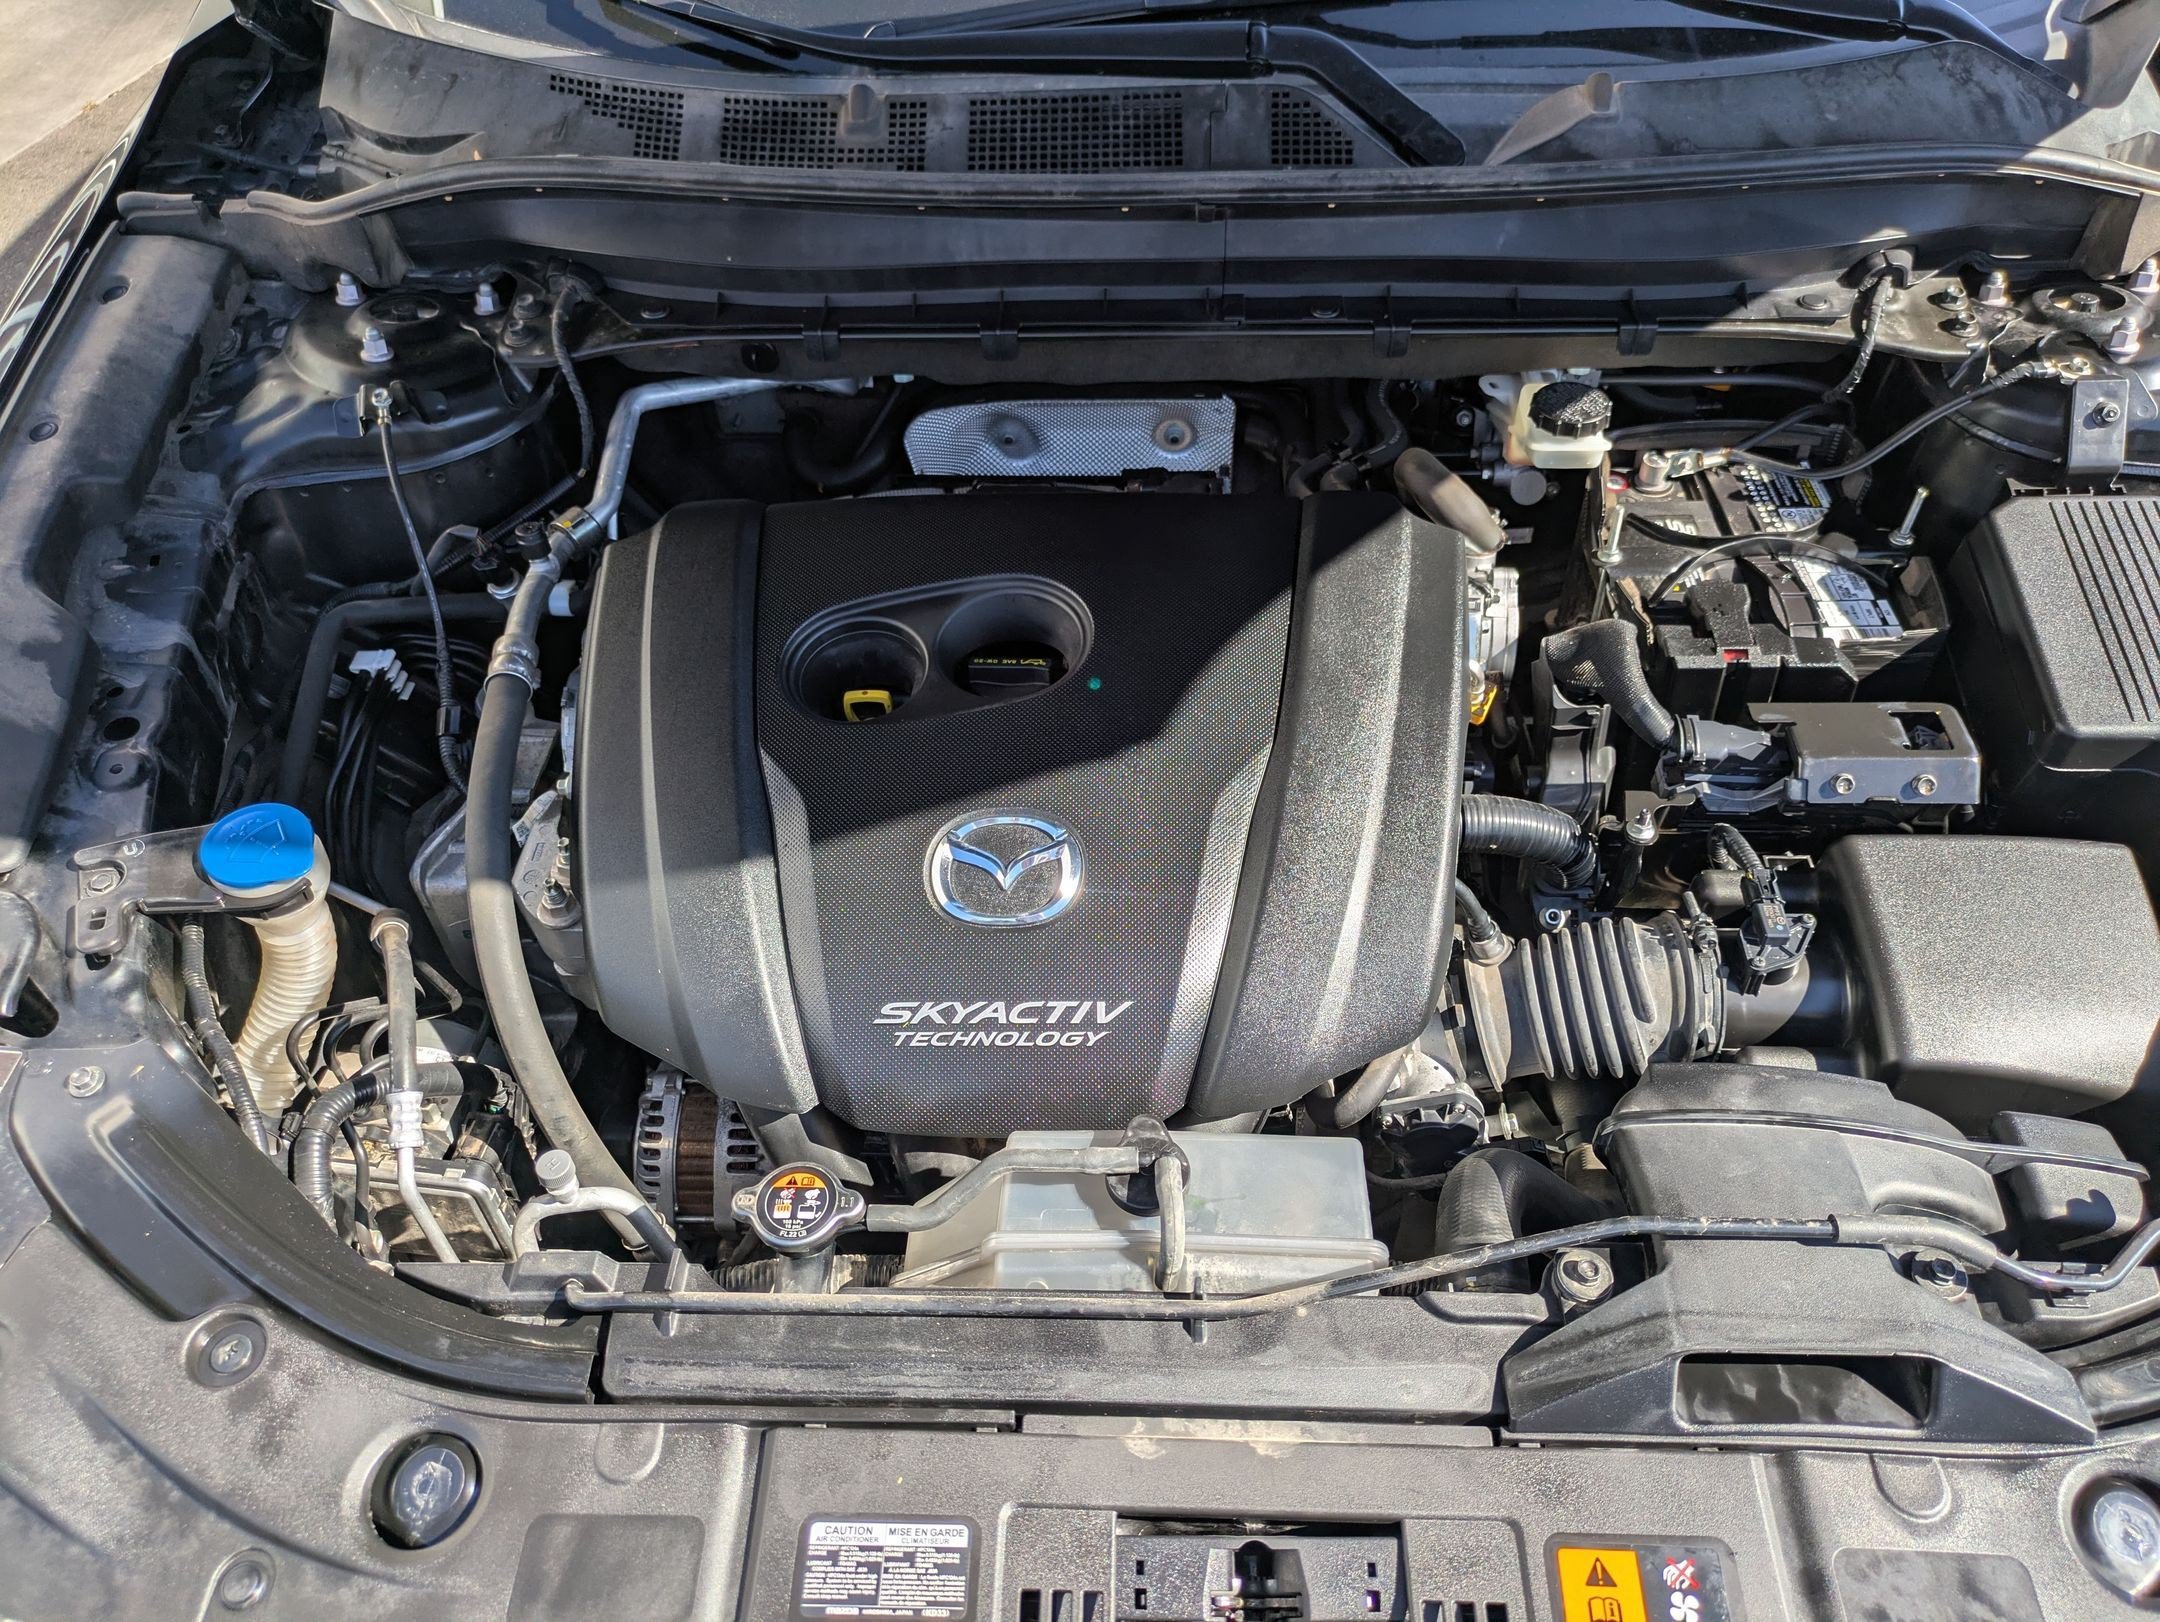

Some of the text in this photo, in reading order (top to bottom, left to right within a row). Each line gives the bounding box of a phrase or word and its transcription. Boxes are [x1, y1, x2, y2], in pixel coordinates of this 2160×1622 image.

[872, 1001, 1134, 1025] SKYACTIV
[893, 1031, 1112, 1047] TECHNOLOGY
[779, 1230, 797, 1238] FL22
[824, 1525, 874, 1535] CAUTION
[888, 1527, 965, 1538] MISE EN GARDE
[901, 1537, 950, 1545] CLIMATISEUR
